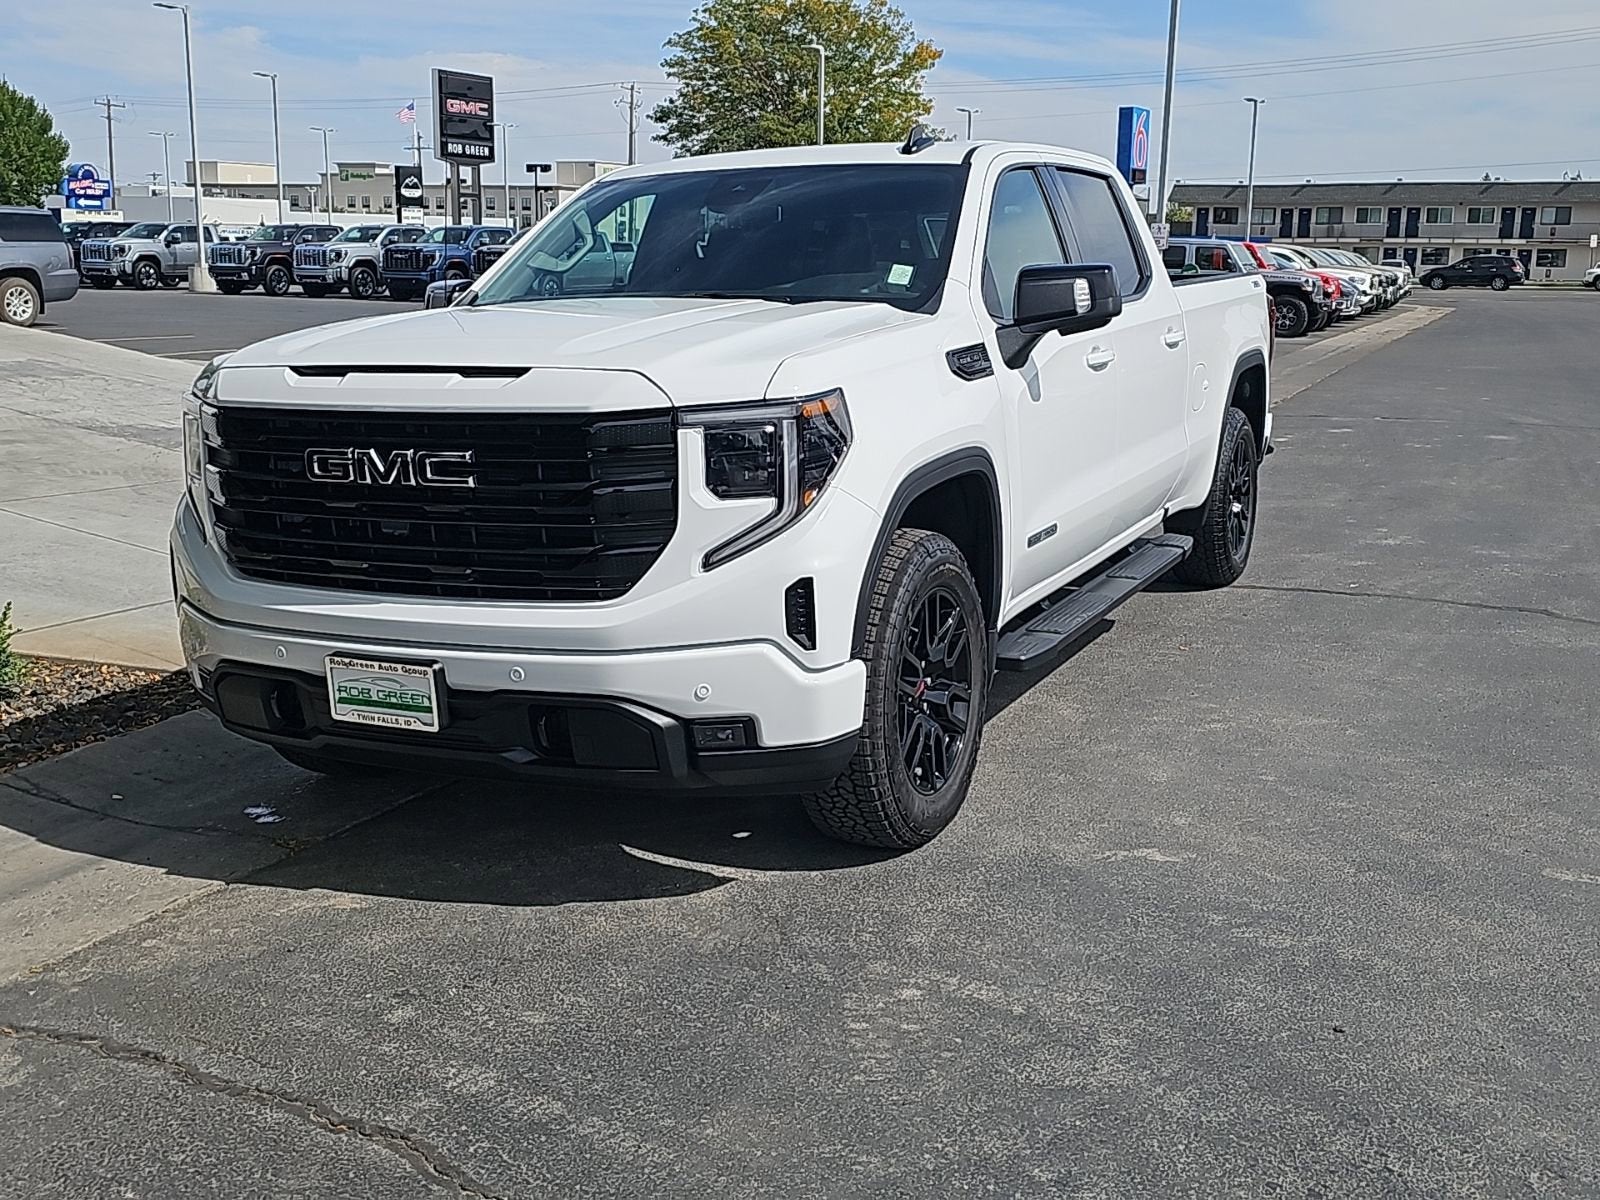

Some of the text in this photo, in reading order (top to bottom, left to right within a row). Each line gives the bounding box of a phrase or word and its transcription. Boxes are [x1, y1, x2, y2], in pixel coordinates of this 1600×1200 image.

[446, 99, 489, 116] GMC
[1133, 110, 1148, 169] 6
[447, 143, 490, 157] ROB GREEN
[304, 448, 475, 488] GMC
[378, 664, 399, 673] Auto
[401, 667, 429, 677] Group
[337, 685, 373, 699] ROB
[376, 689, 432, 705] GREEN
[356, 713, 376, 722] TWIN
[403, 719, 412, 727] ID
